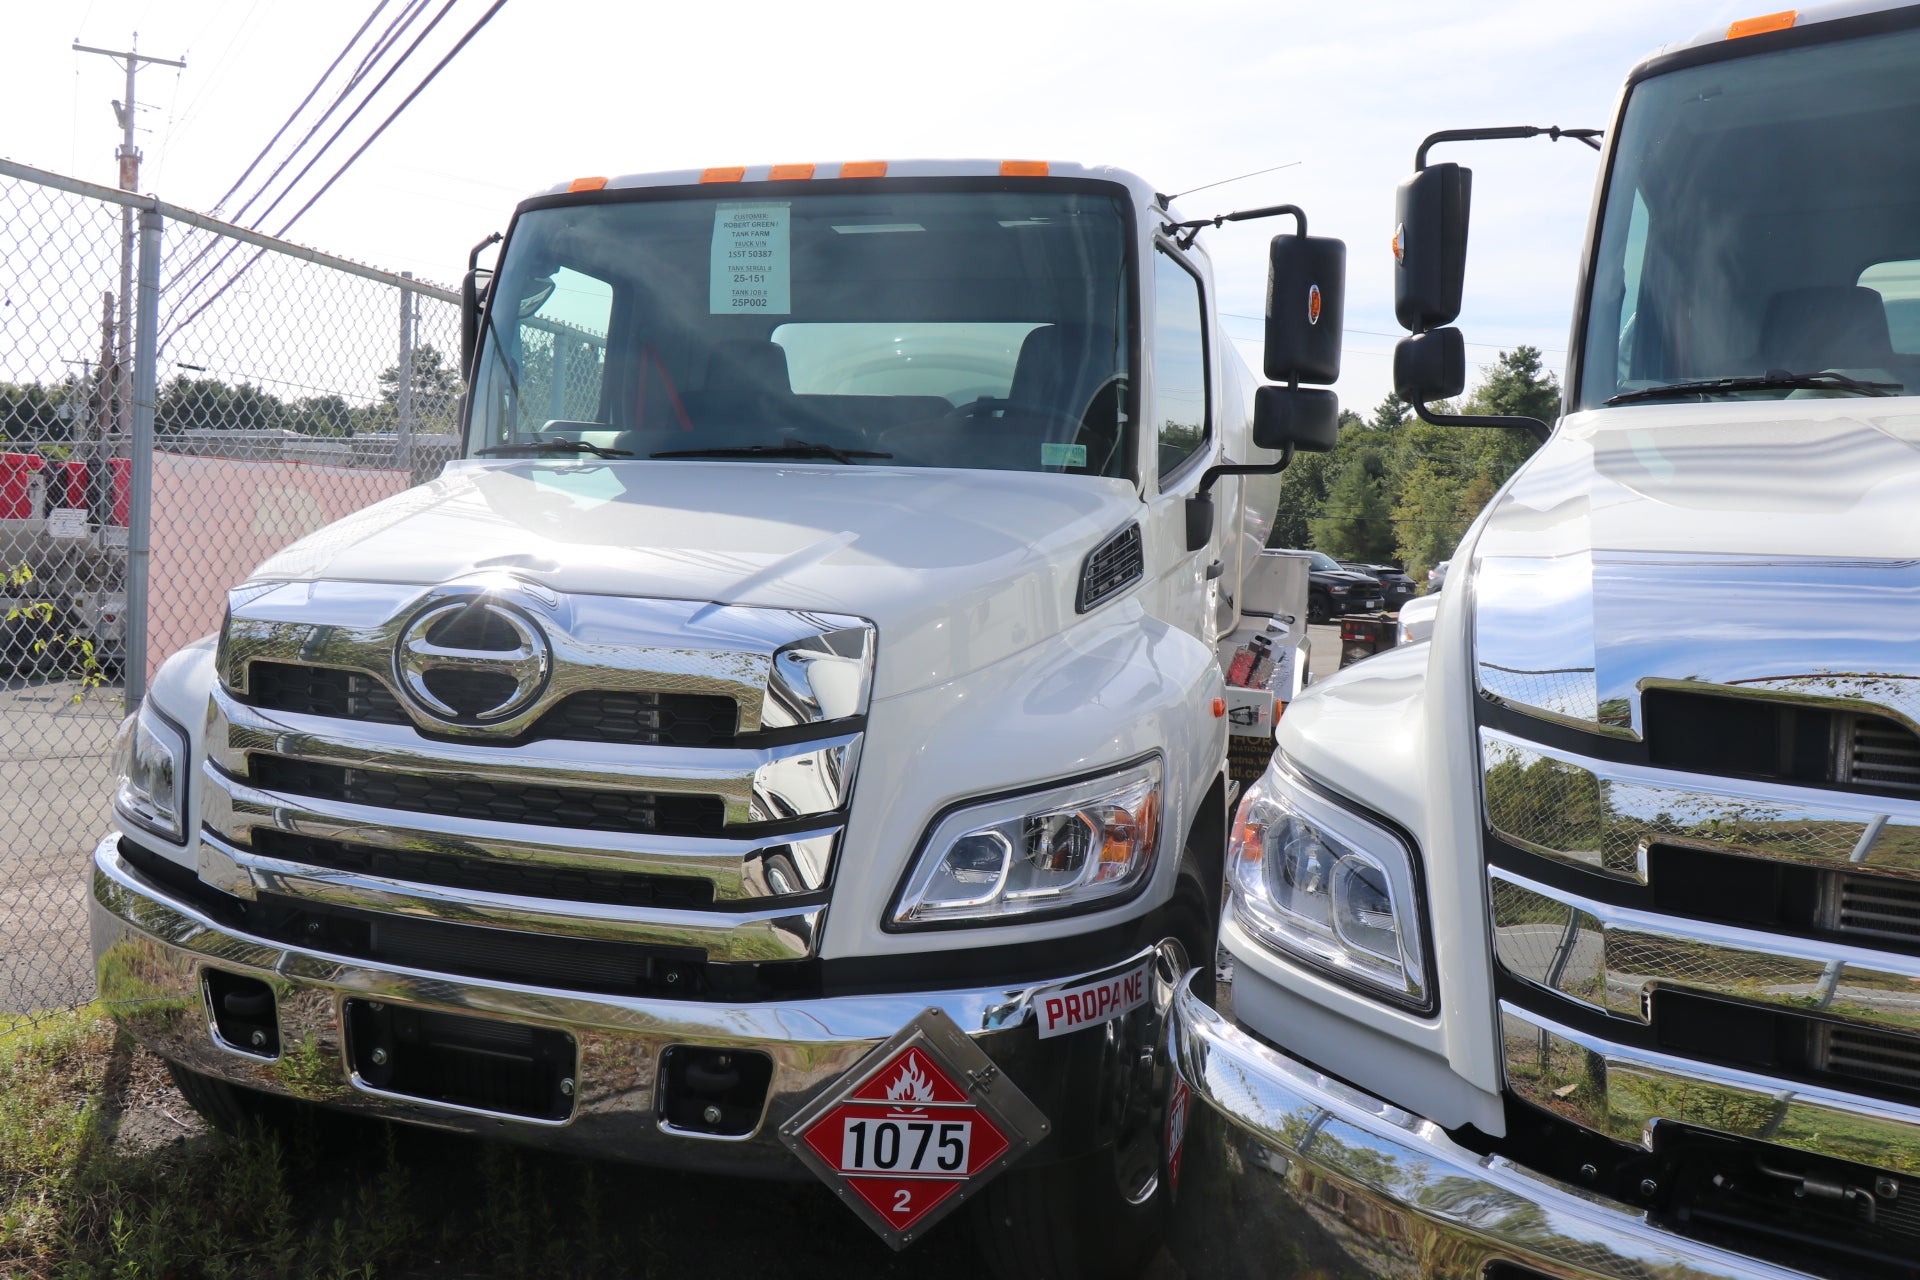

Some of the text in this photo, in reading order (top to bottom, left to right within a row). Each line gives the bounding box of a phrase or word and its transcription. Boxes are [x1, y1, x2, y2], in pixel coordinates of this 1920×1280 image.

[723, 221, 750, 229] ROBERT
[735, 240, 754, 248] TRUCK
[748, 250, 773, 258] 50387
[733, 274, 765, 283] 25-151
[731, 298, 767, 307] 25P002
[1045, 970, 1143, 1030] PROPANE
[849, 1121, 964, 1171] 1075
[892, 1189, 912, 1212] 2
